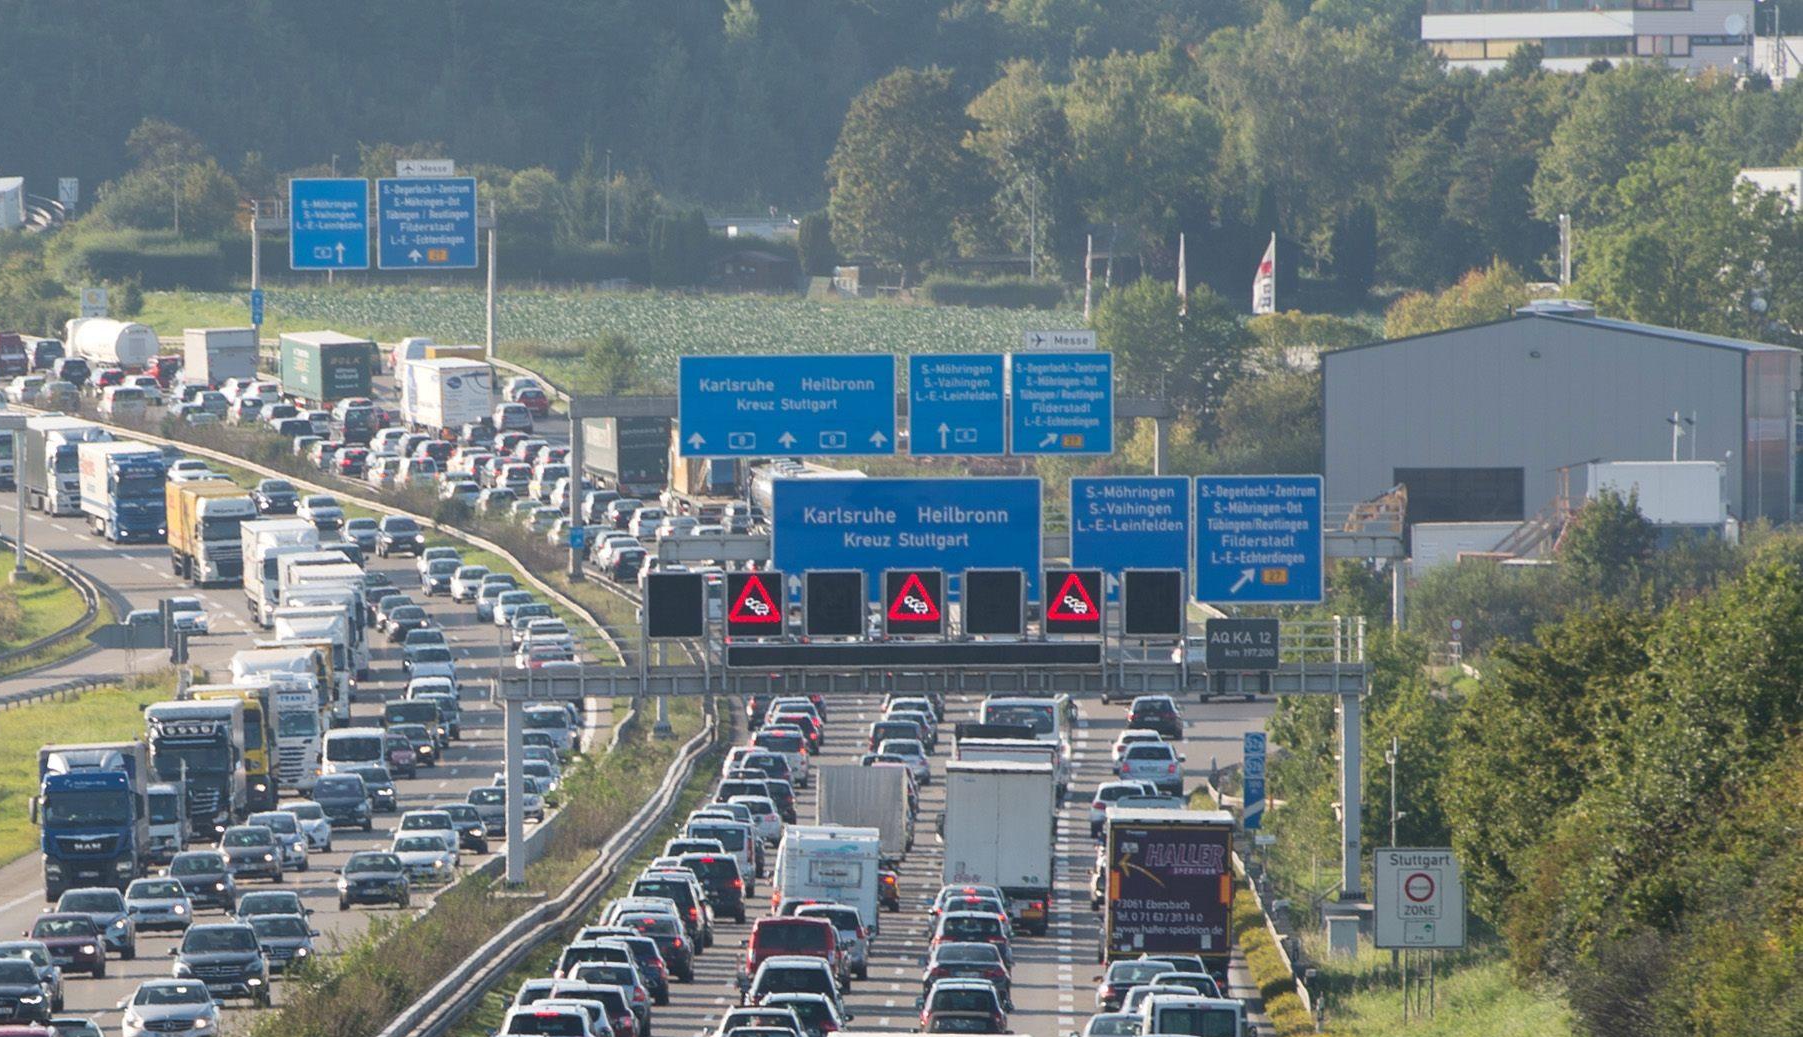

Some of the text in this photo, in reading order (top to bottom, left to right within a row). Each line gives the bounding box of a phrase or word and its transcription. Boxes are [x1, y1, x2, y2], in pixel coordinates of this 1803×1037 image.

[1054, 336, 1089, 345] Messe
[921, 363, 993, 377] S.-Möhringen
[699, 377, 875, 392] Karlsruhe Heilbronn
[923, 377, 990, 390] S.-Vaihingen
[915, 391, 998, 401] L.-E.-Leinfelden
[736, 398, 838, 413] Kreuz Stuttgart
[1032, 402, 1091, 413] Filderstadt
[1085, 486, 1175, 500] S.-Möhringen
[1201, 484, 1317, 500] S.-Degerloch/-Zentrum
[804, 506, 1009, 524] Karlsruhe Heilbronn
[1089, 502, 1172, 517] S.-Vaihingen
[1213, 502, 1303, 516] S.-Möhringen-Ost
[1077, 520, 1184, 532] L.-E.-Leinfelden
[844, 532, 969, 550] Kreuz Stuttgart
[1221, 535, 1295, 548] Filderstadt
[1211, 552, 1306, 566] L.-E.-Echterdingen
[1269, 571, 1281, 581] 27
[1210, 632, 1272, 644] AQ KA 12
[1224, 648, 1240, 657] km
[1144, 843, 1225, 873] HALLER
[1389, 853, 1451, 868] Stuttgart
[1146, 899, 1191, 910] Ebersbach
[1404, 904, 1435, 916] ZONE
[1116, 911, 1131, 920] Tel.
